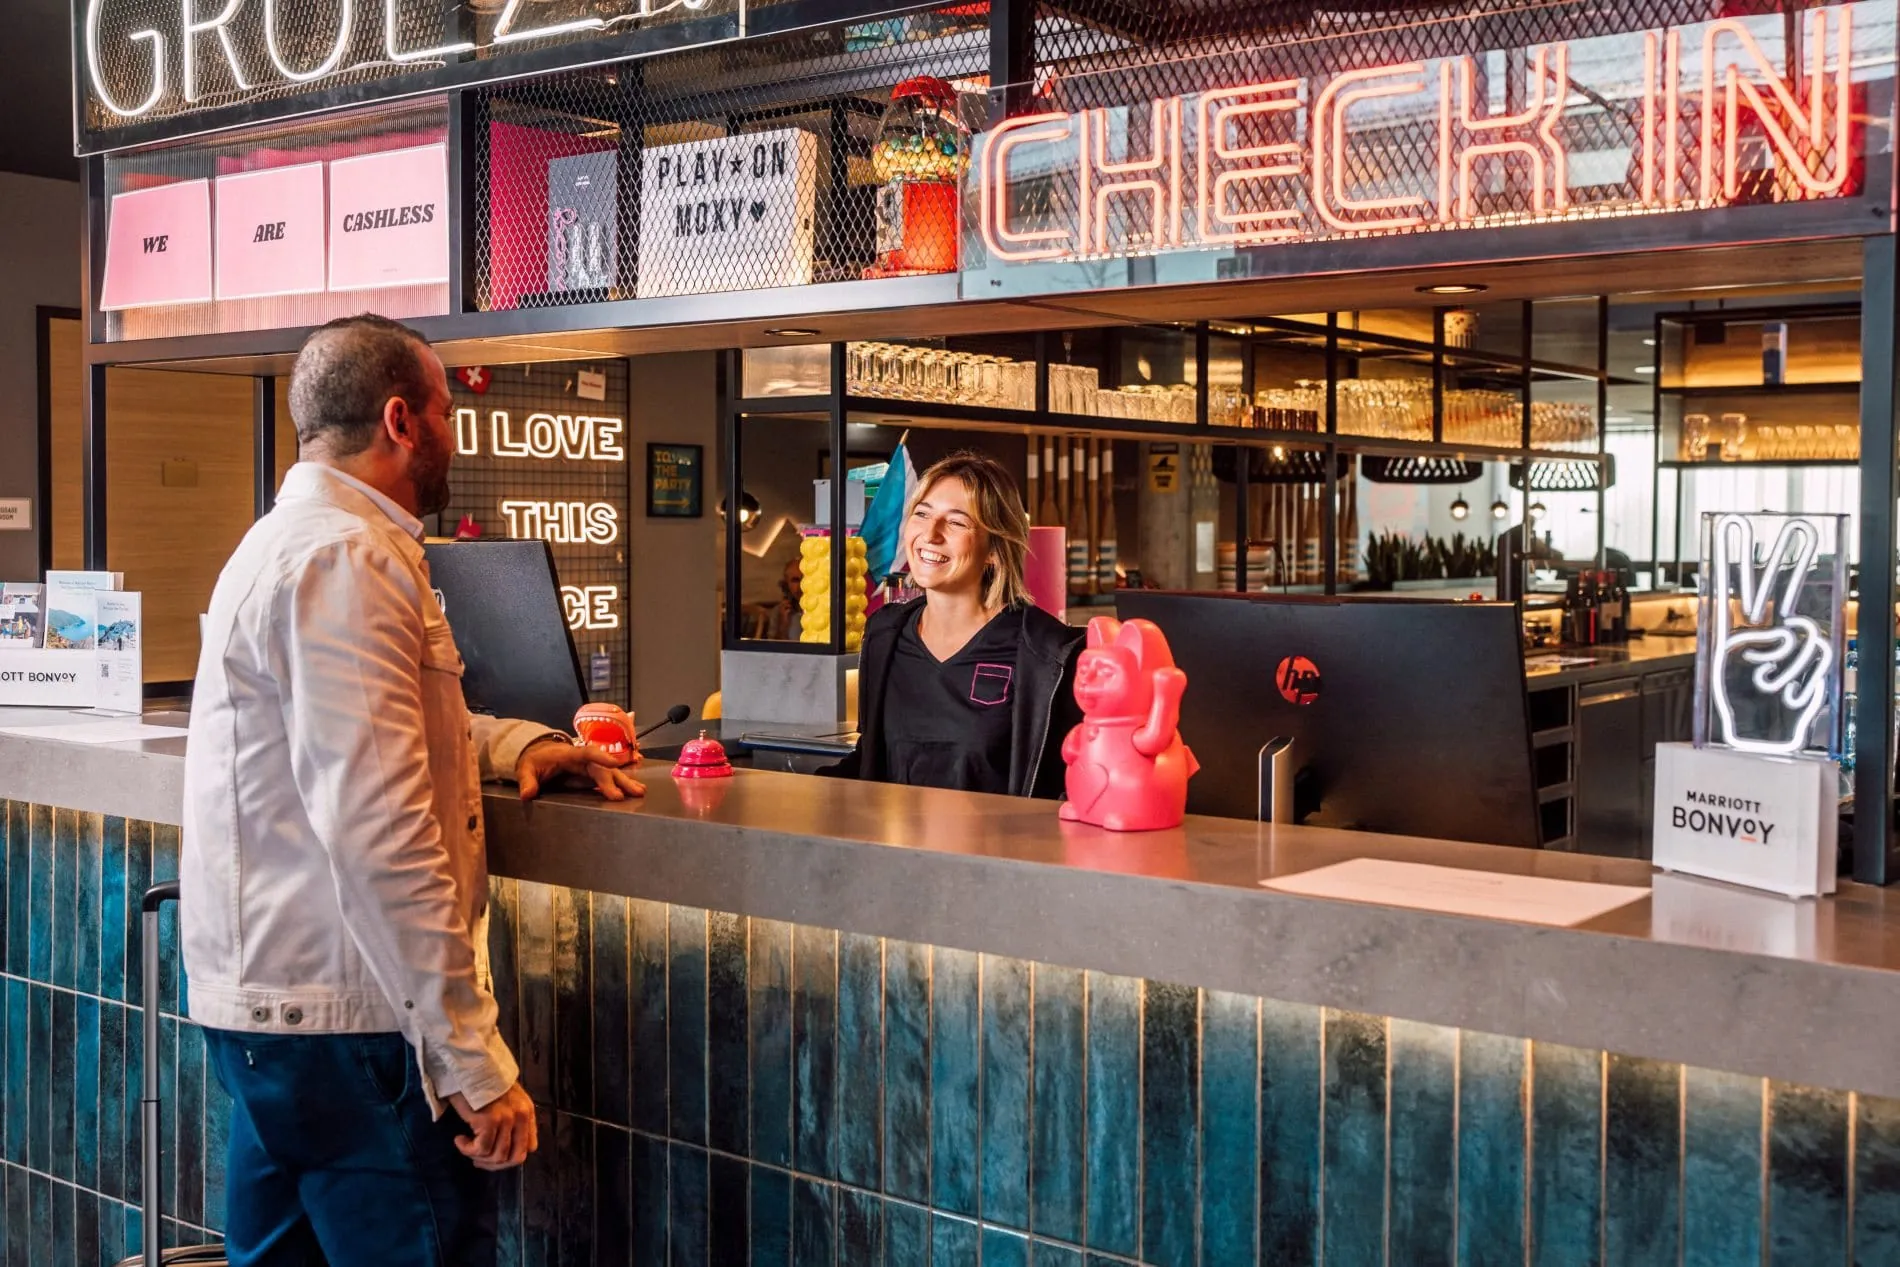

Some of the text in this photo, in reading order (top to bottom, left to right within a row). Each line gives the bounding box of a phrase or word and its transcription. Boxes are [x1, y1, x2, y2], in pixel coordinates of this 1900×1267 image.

[981, 2, 1854, 262] CHECK IN
[658, 141, 785, 189] PLAY ON
[142, 203, 435, 254] WE ARE CASHLESS
[675, 197, 742, 238] MOXY
[456, 408, 624, 461] I LOVE
[502, 501, 618, 545] THIS
[28, 672, 77, 682] BONVOY
[1686, 790, 1762, 813] MARRIOTT
[1672, 806, 1775, 844] BONVOY
